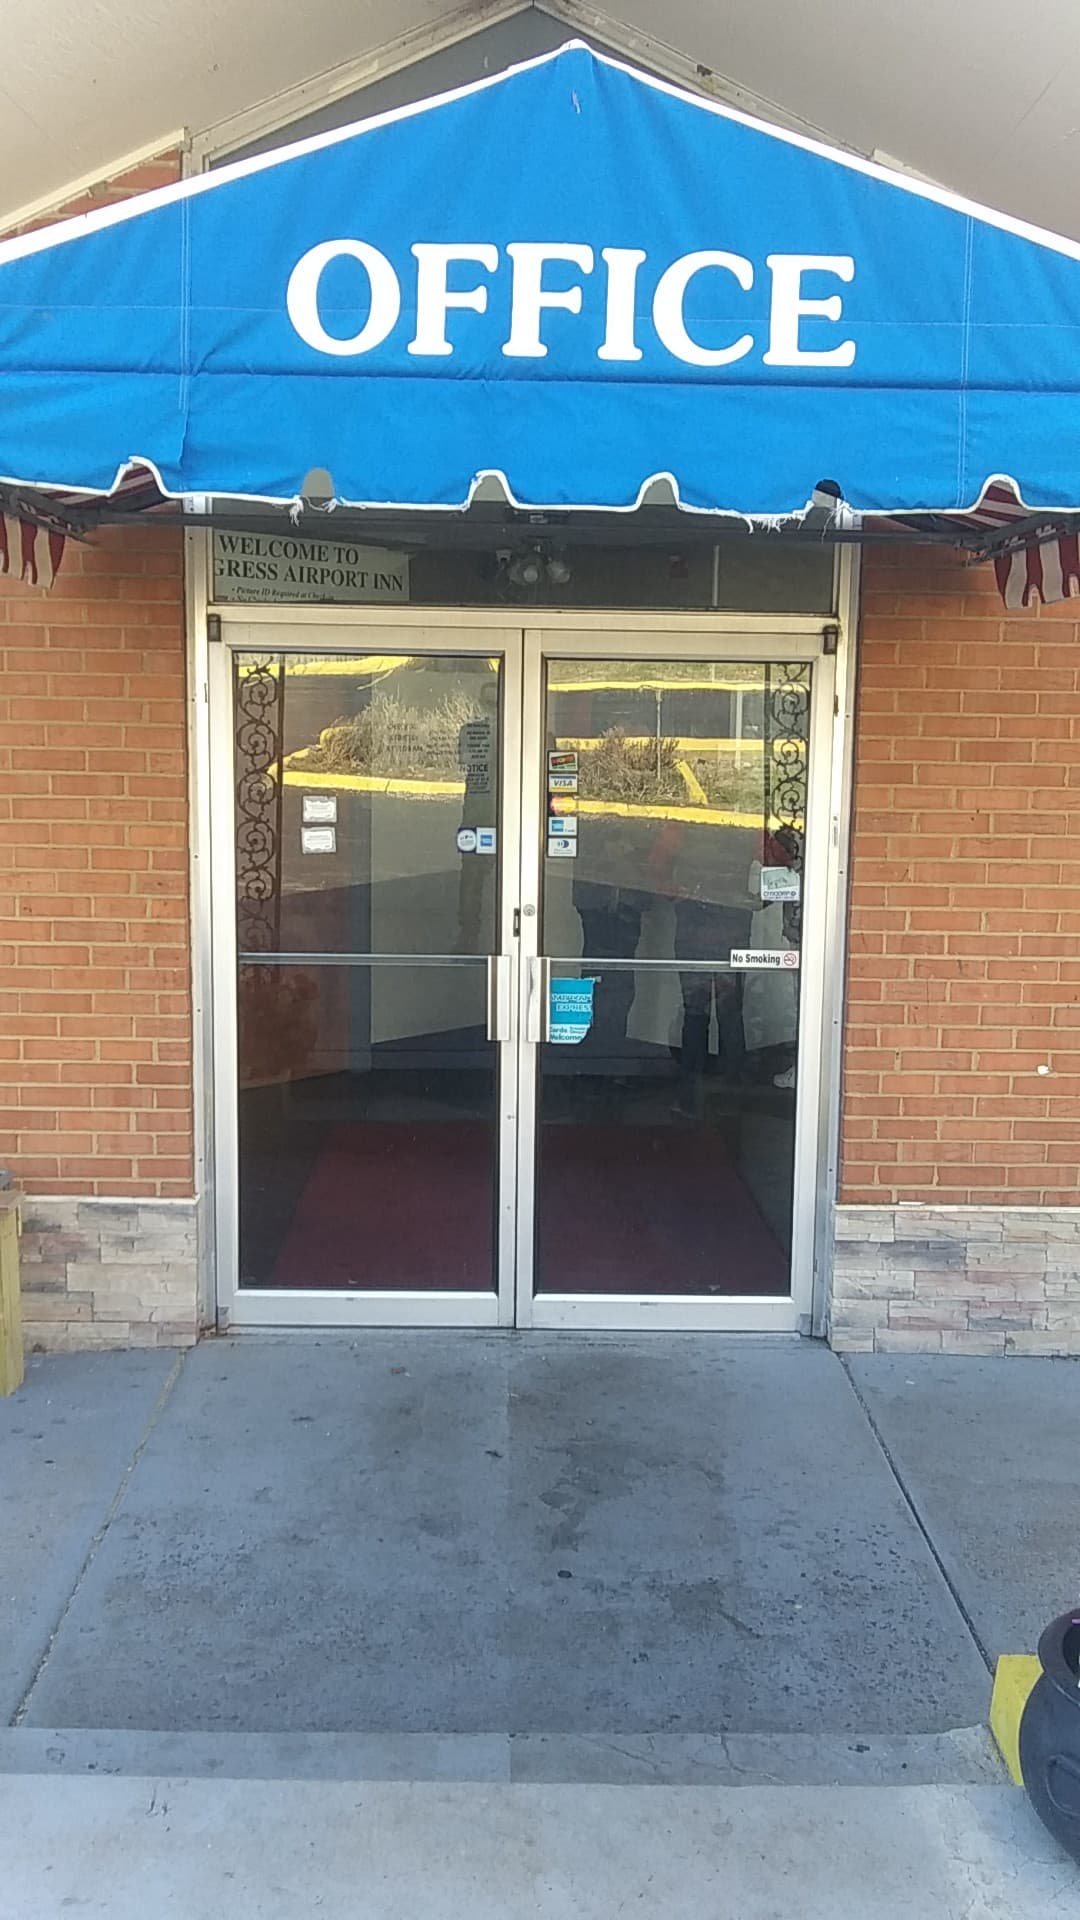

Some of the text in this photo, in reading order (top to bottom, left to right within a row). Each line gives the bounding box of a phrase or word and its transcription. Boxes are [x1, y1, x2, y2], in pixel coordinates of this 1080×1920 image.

[286, 239, 856, 367] OFFICE
[218, 534, 359, 566] WELCOME TO
[215, 558, 404, 592] GRESS AIRPORT INN
[236, 586, 260, 595] Picture
[261, 587, 271, 596] ID
[272, 588, 300, 599] Required
[459, 763, 489, 773] NOTICE
[553, 779, 574, 787] VISA
[732, 954, 781, 966] No Smoking
